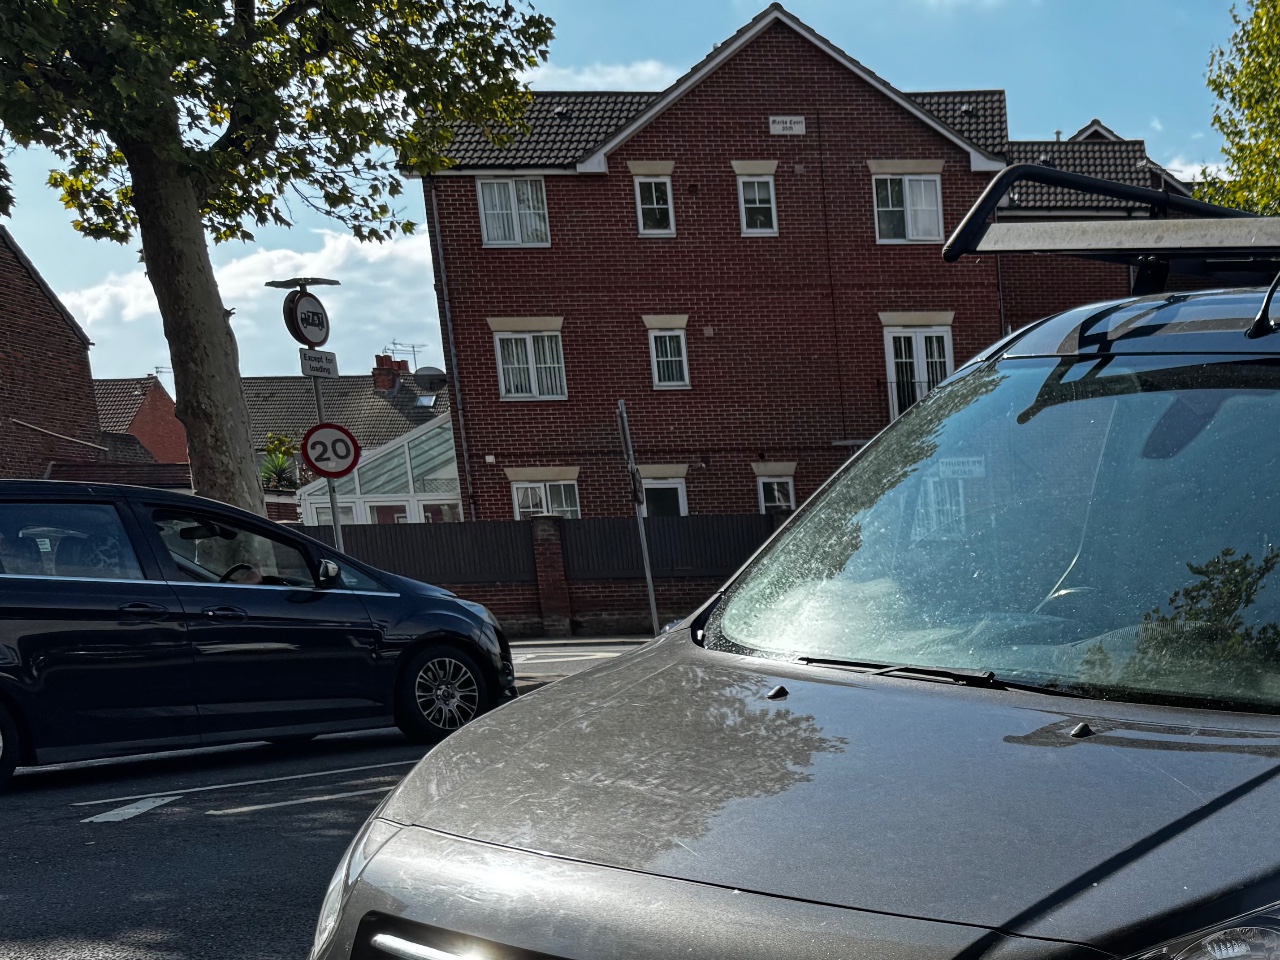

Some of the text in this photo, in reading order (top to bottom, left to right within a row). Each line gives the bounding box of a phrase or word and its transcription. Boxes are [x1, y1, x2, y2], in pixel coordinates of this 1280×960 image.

[303, 353, 334, 365] Except for
[309, 364, 331, 375] loading
[310, 438, 351, 463] 20
